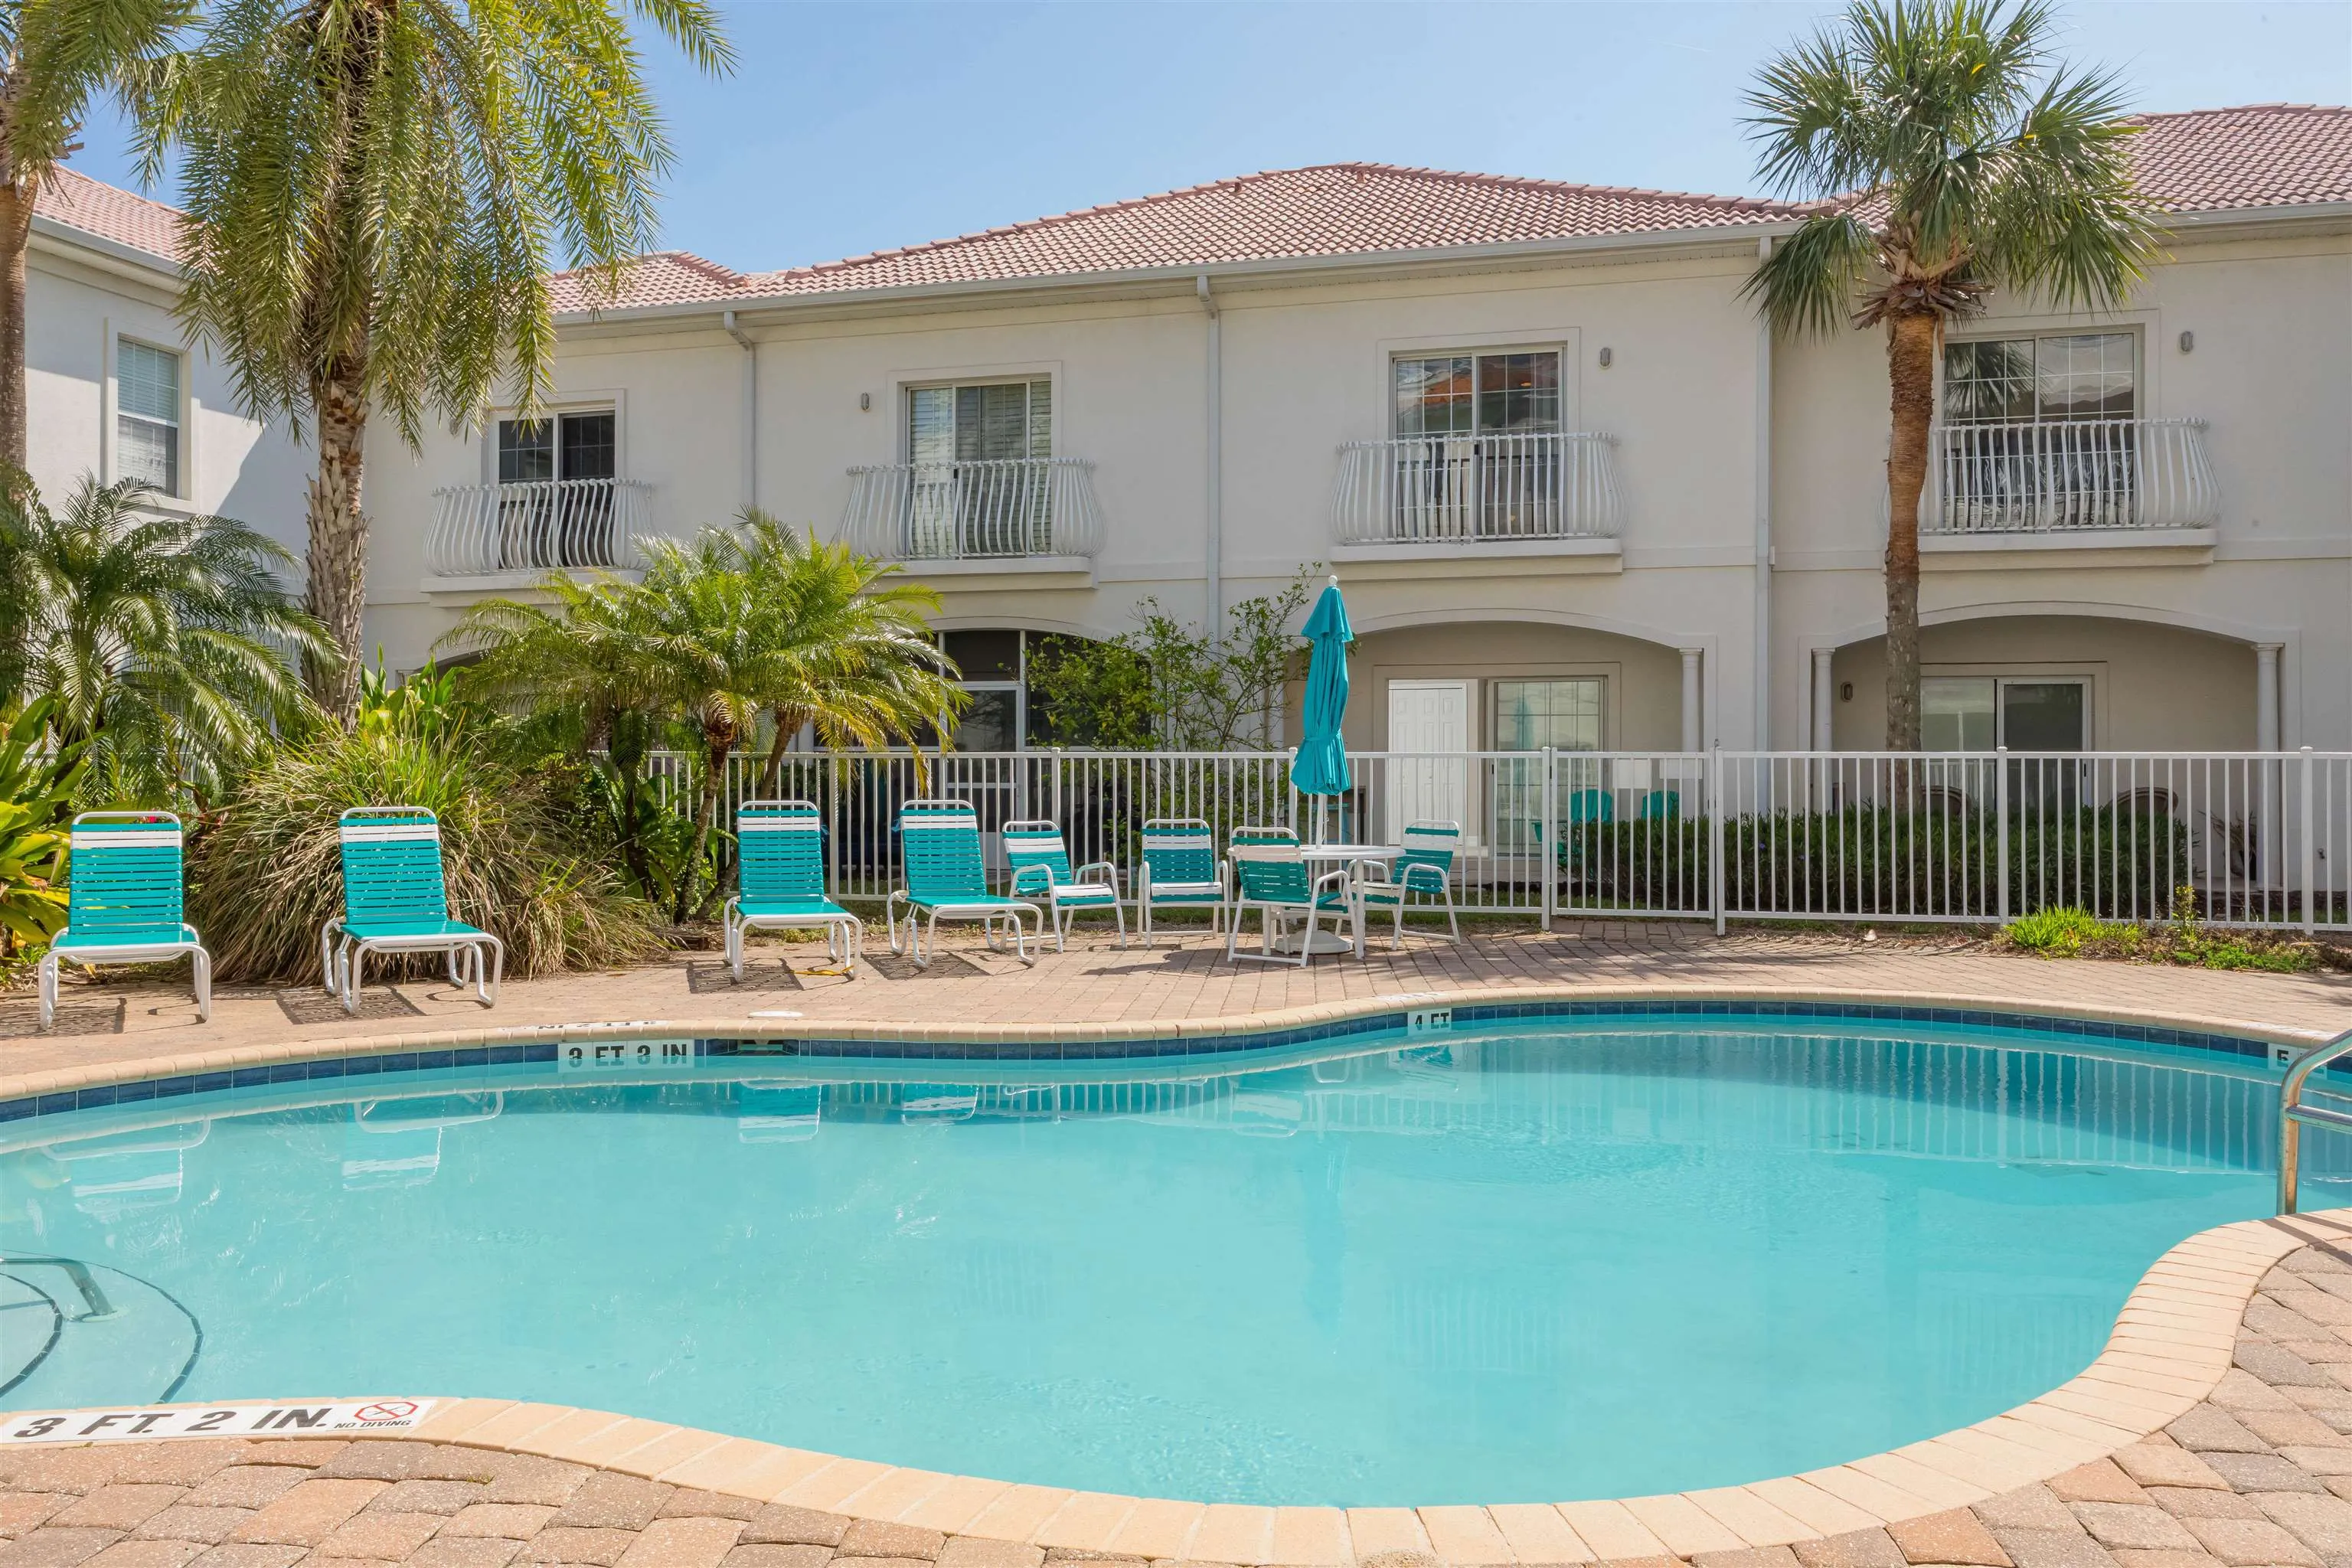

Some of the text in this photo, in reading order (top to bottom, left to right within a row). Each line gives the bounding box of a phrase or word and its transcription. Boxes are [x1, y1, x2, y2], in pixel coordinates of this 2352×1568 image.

[595, 1045, 625, 1059] FT
[662, 1044, 687, 1057] IN
[13, 1407, 332, 1438] 3 FT. 2 IN.
